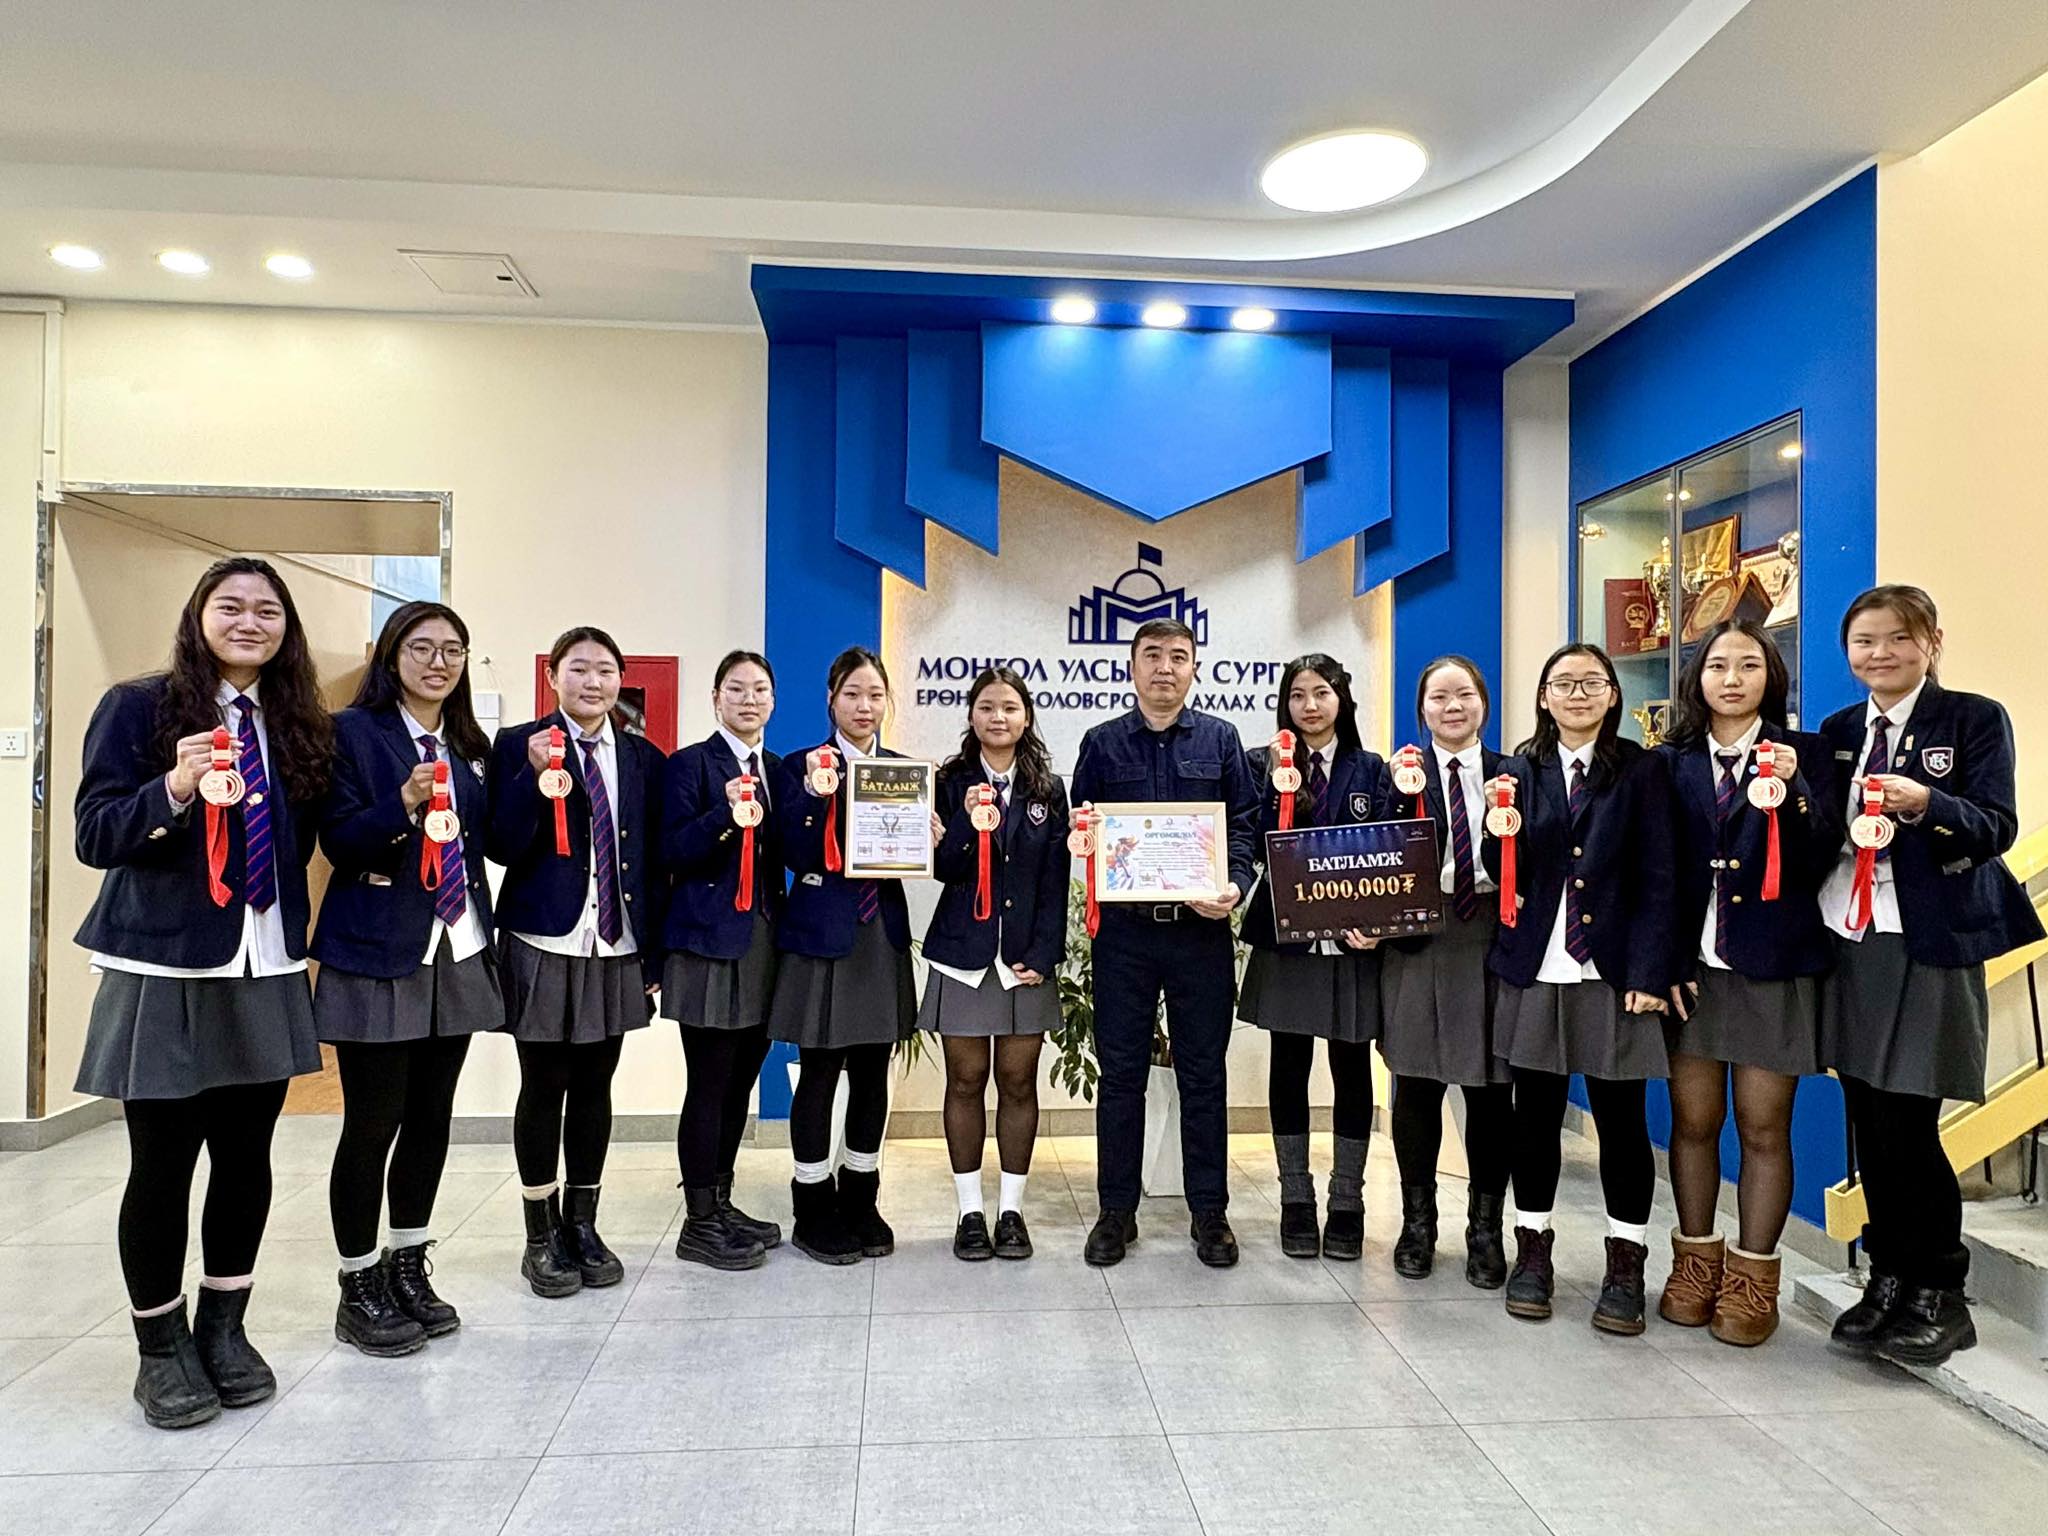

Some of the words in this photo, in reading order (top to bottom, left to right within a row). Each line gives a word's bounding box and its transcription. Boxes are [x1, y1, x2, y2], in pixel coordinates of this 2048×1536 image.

[1058, 658, 1132, 683] УЛСЫ
[917, 689, 970, 706] ЕРӨН
[1191, 693, 1255, 711] АХЛАХ
[1308, 851, 1403, 872] БАТЛАМЖ
